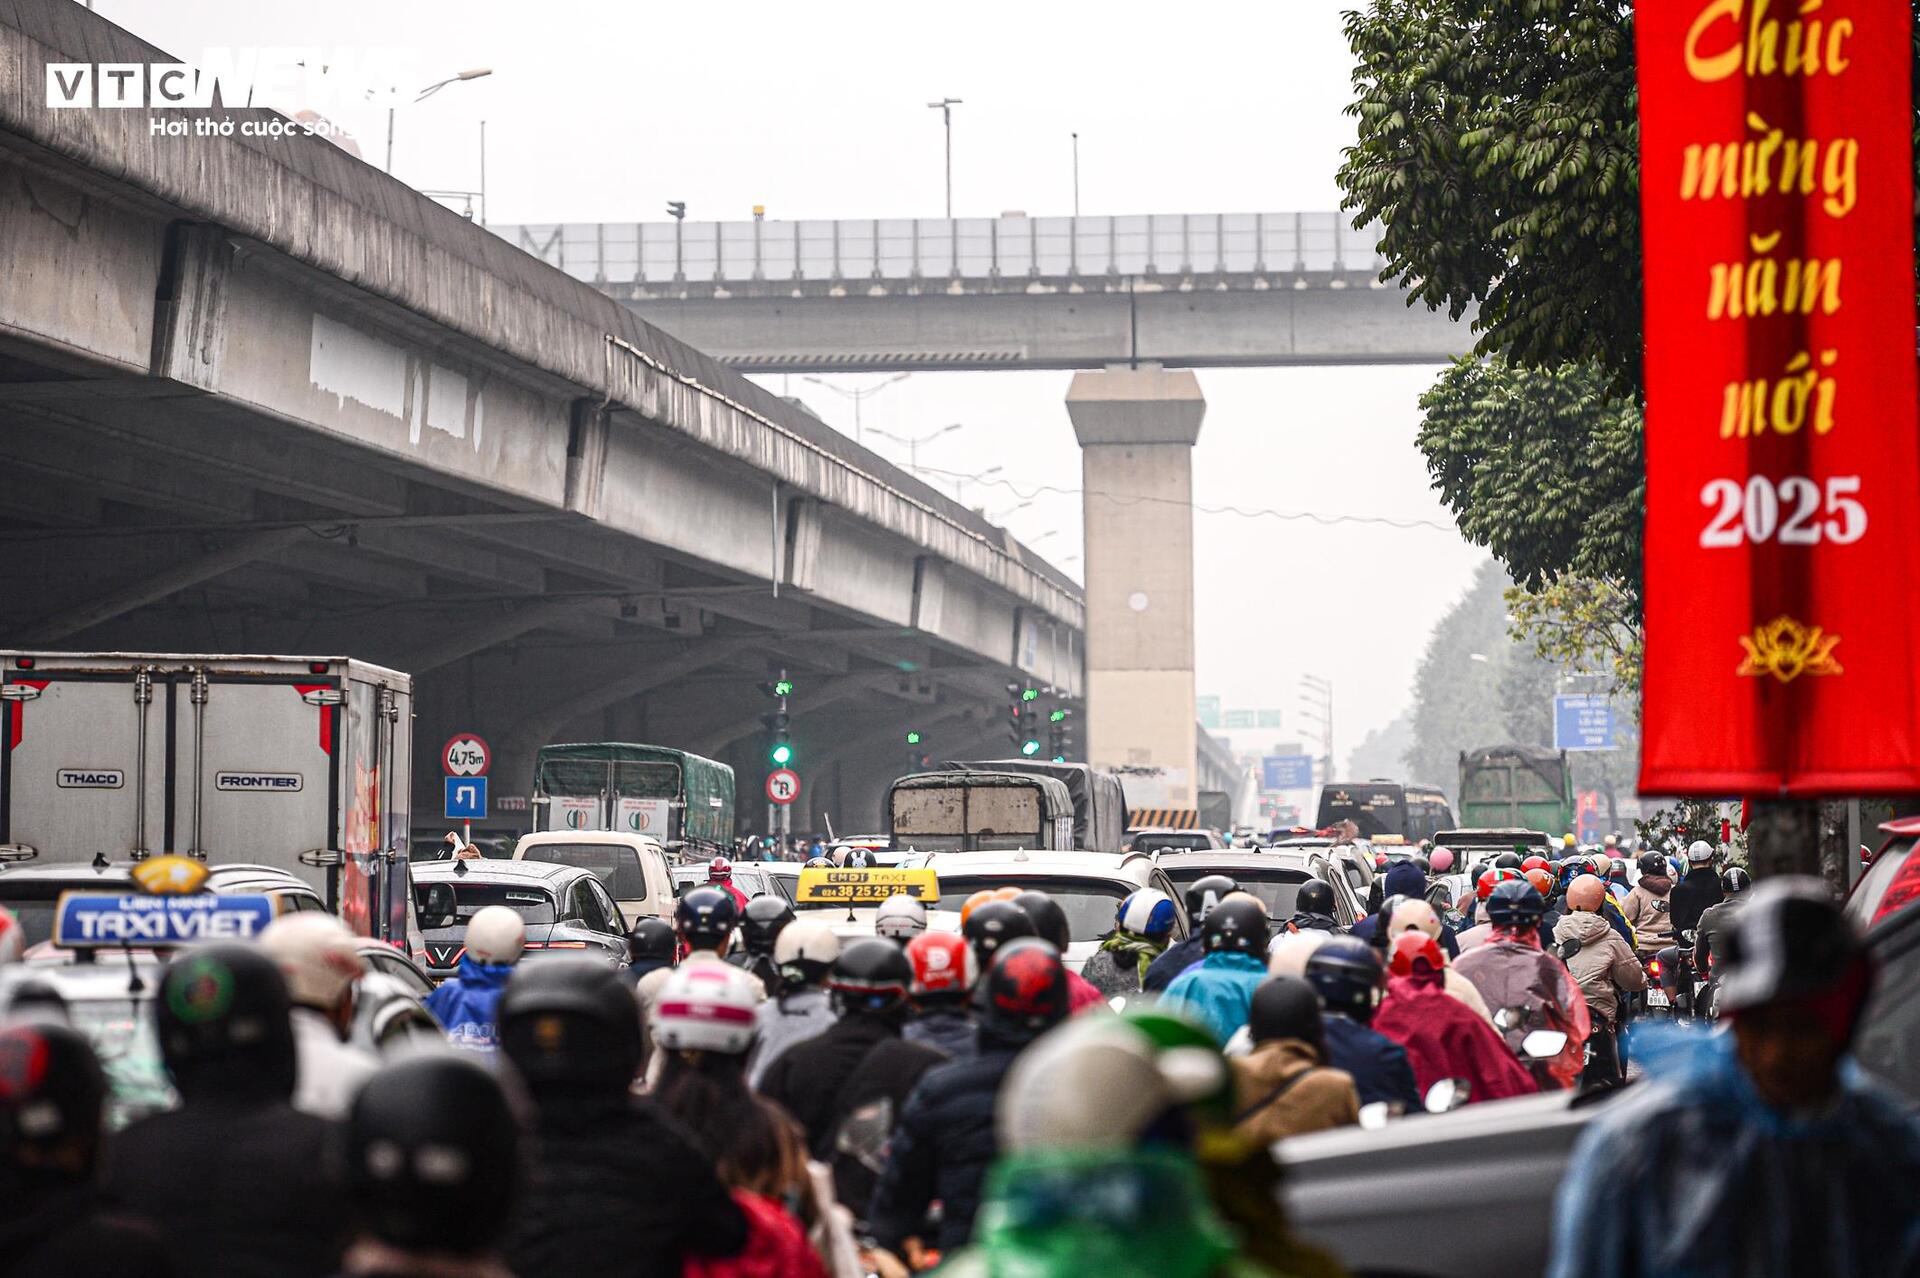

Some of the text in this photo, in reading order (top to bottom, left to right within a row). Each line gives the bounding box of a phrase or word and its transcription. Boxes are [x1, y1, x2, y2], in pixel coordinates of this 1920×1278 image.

[1684, 0, 1854, 83] Chúc
[1680, 110, 1859, 218] mừng
[1707, 229, 1843, 320] năm
[1719, 347, 1838, 440] mới
[1699, 474, 1869, 549] 2025
[63, 773, 118, 785] THACO
[220, 776, 297, 788] FRONTIER
[821, 885, 908, 897] 024 38 25 25 25
[873, 874, 908, 882] TAXI
[75, 910, 167, 938] TAXI
